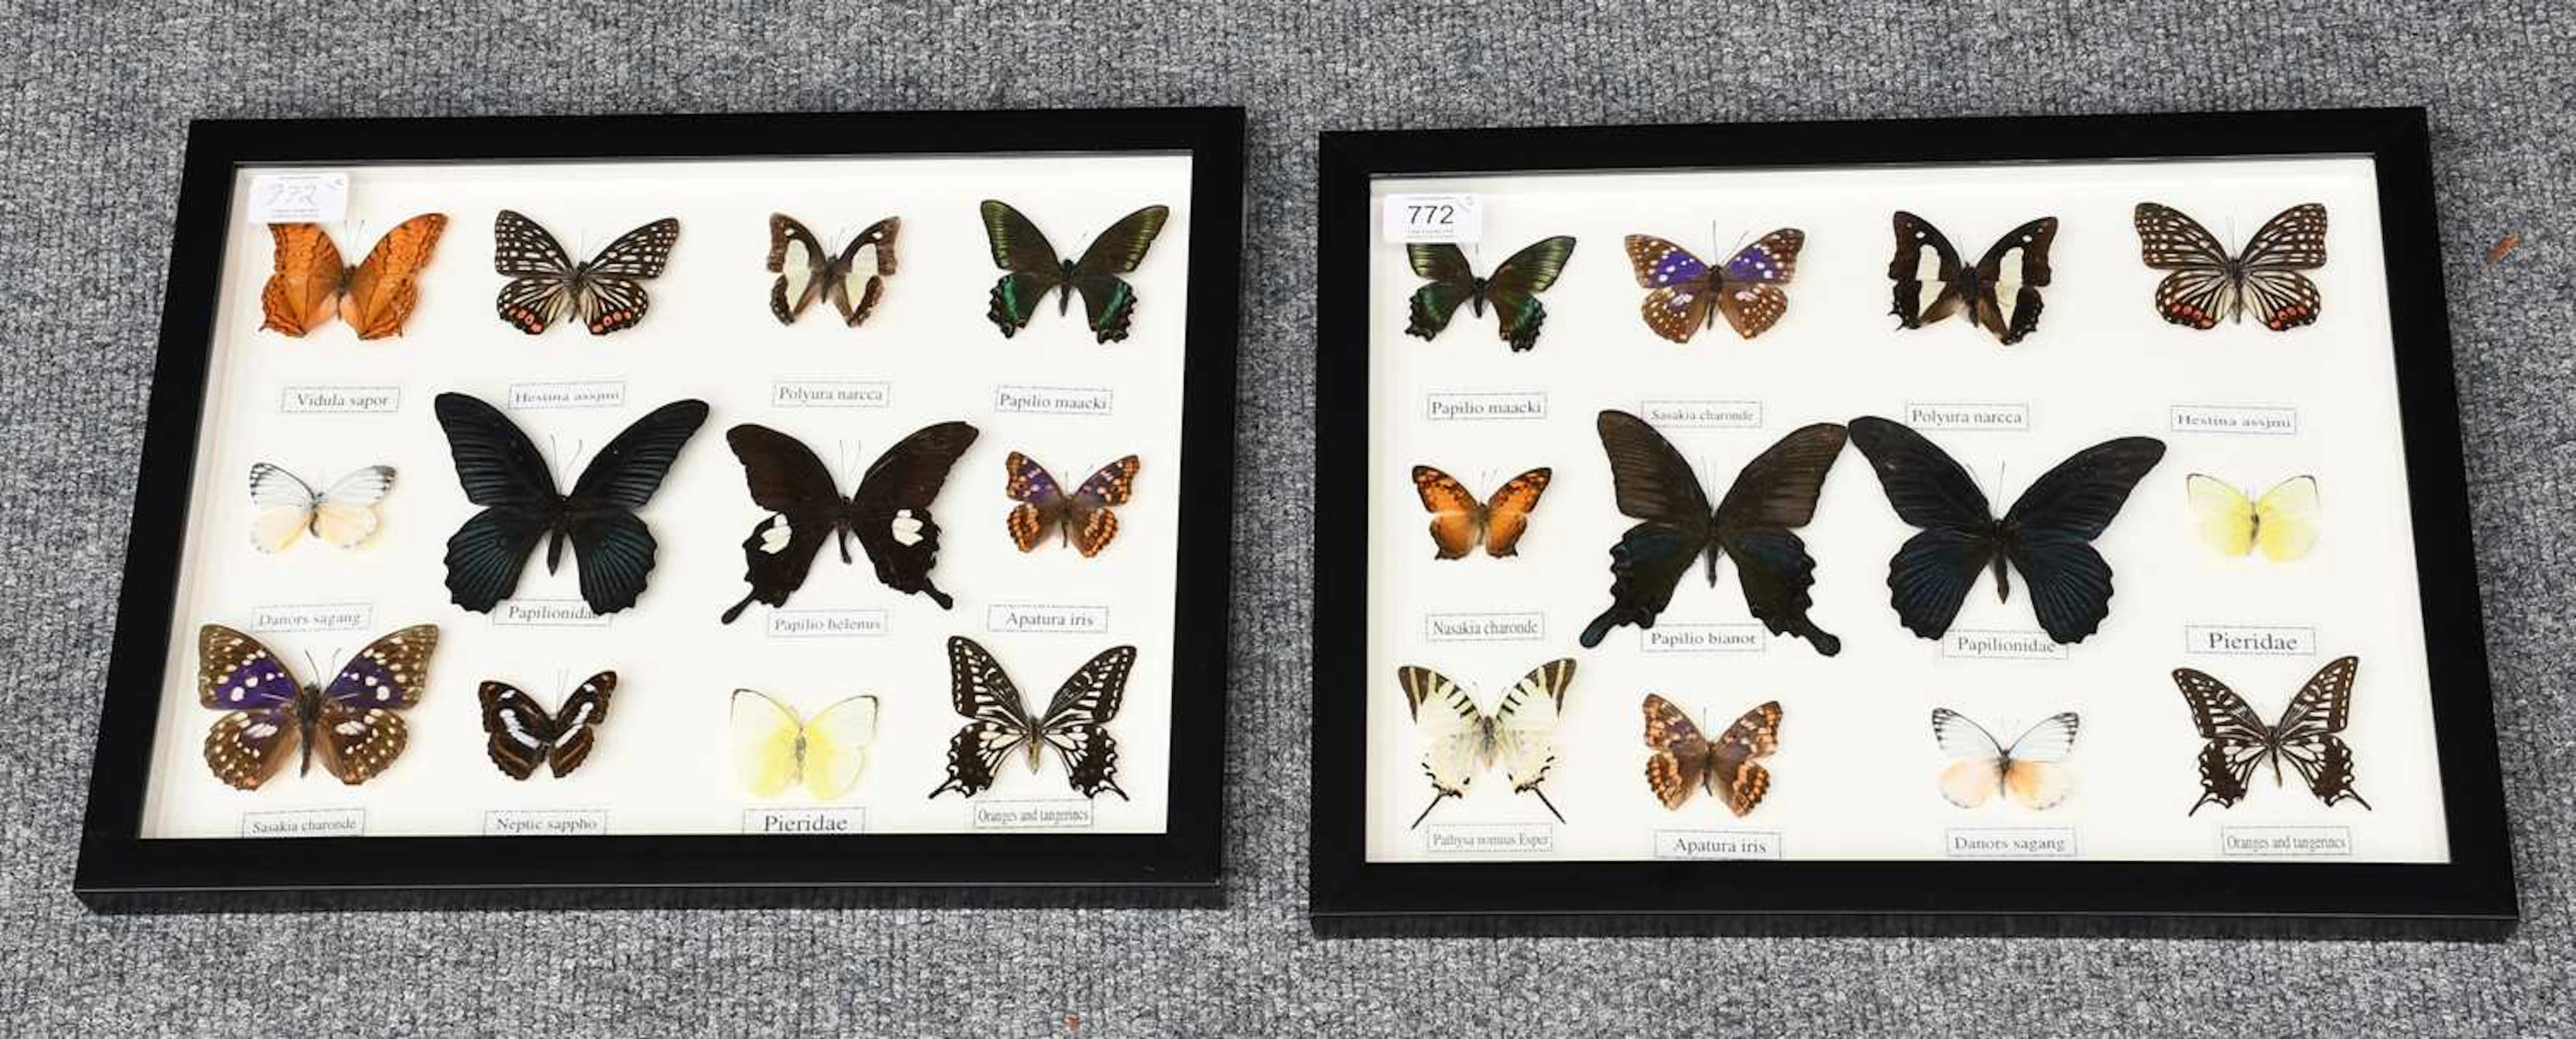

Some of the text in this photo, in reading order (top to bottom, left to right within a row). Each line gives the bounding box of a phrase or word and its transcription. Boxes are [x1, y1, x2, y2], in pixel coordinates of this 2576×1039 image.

[1408, 205, 1454, 225] 772
[298, 394, 388, 409] Vidula sapor
[780, 387, 833, 402] Polyura
[1000, 394, 1106, 410] Papilio maacki
[1432, 402, 1541, 416] Papilio maacki
[1652, 411, 1753, 421] Sasakia charonde
[1912, 411, 1969, 426] Polyura
[313, 613, 360, 627] sagang
[775, 618, 824, 632] Papilio
[1006, 612, 1093, 626] Apatura iris
[1484, 621, 1538, 635] charonde
[1652, 633, 1756, 647] Papilio bianor
[1958, 637, 2055, 653] Papilionidae
[2209, 632, 2298, 651] Pieridae
[765, 816, 848, 832] Pieridae
[978, 810, 1017, 824] Oranges
[1021, 810, 1038, 820] and
[252, 819, 356, 834] Sasakia charonde
[547, 819, 597, 832] sappho
[1674, 838, 1766, 854] Apatura iris
[2013, 840, 2064, 853] sagang
[2226, 836, 2269, 851] Oranges
[2273, 836, 2290, 849] and
